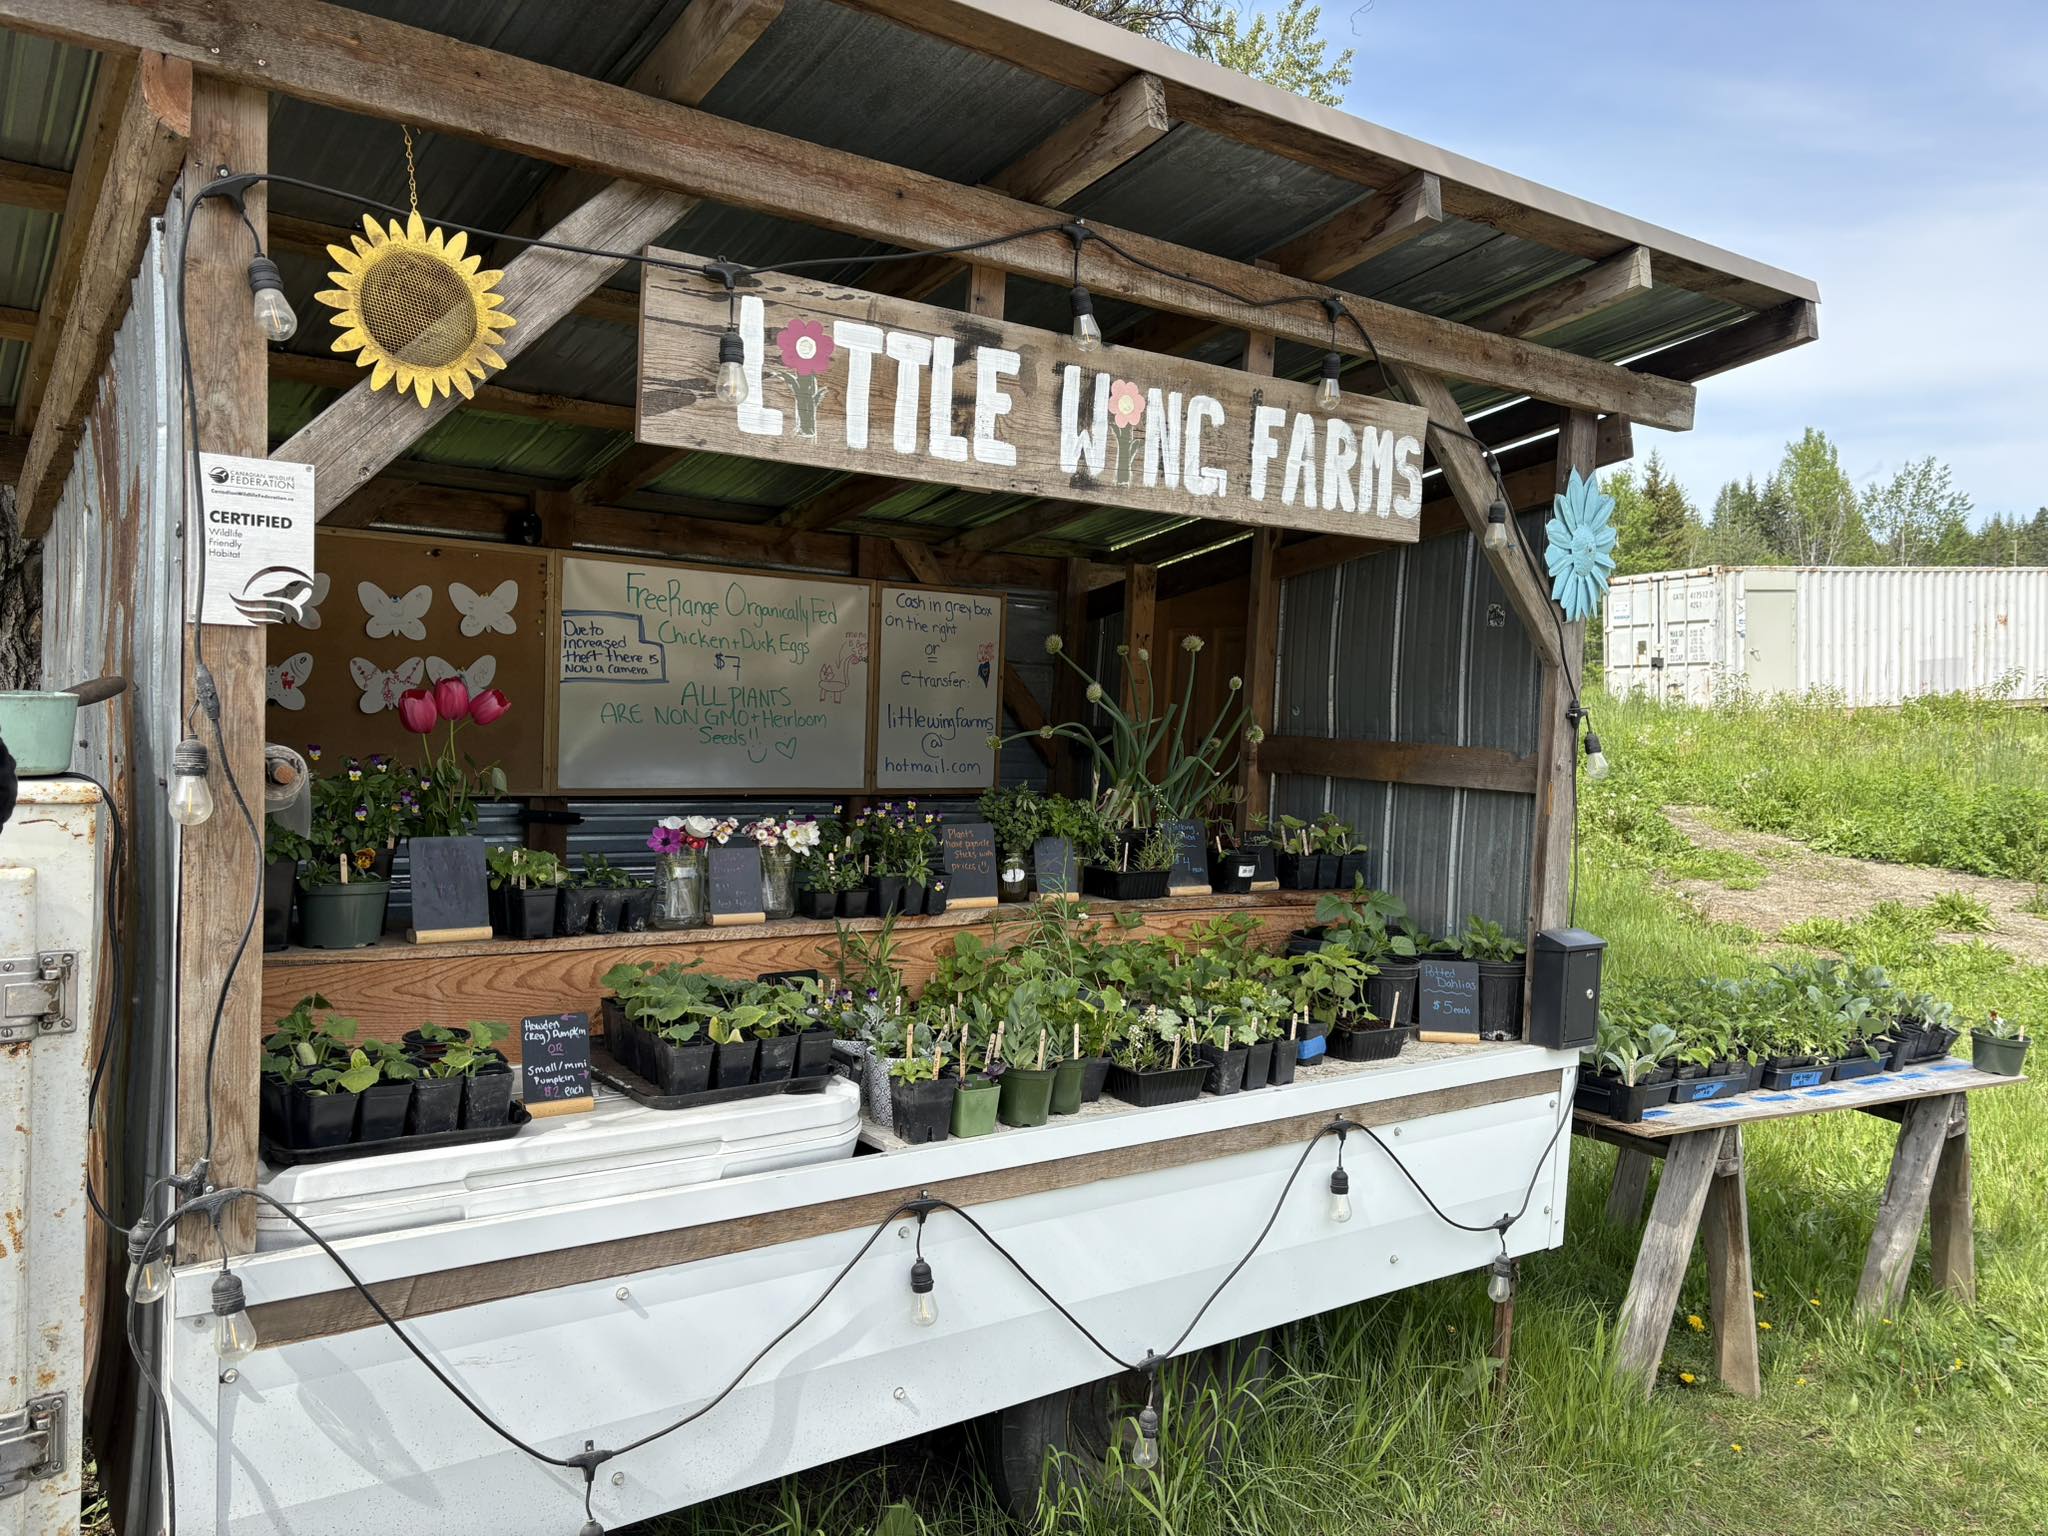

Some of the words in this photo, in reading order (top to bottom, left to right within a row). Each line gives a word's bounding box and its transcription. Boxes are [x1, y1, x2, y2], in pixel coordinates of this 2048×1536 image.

[1251, 405, 1423, 519] FARMS
[230, 470, 266, 478] CANADIAN
[268, 474, 295, 482] WILDLIFE
[230, 476, 295, 489] FEDERATION
[209, 510, 293, 529] CERTIFIED
[208, 528, 243, 538] Wildlife
[209, 538, 242, 548] Friendly
[209, 549, 241, 558] Habitat
[726, 582, 809, 638] Organically
[810, 597, 837, 625] Fed
[896, 593, 925, 610] Cash
[929, 599, 942, 613] in
[945, 600, 972, 622] grey
[974, 600, 993, 617] box
[563, 620, 588, 636] Due
[590, 621, 604, 636] to
[885, 612, 904, 626] on
[906, 614, 928, 633] the
[932, 622, 958, 643] right
[563, 636, 627, 650] increased
[658, 620, 730, 649] Chicken
[740, 628, 776, 655] Duck
[780, 633, 810, 664] Eggs
[562, 649, 602, 663] theft
[605, 649, 643, 663] there
[649, 654, 659, 664] is
[924, 643, 940, 656] or
[596, 666, 604, 674] a
[608, 665, 648, 675] camera
[714, 652, 741, 682] $7
[681, 681, 727, 706] ALL
[600, 702, 643, 724] ARE
[654, 705, 699, 726] NON
[705, 706, 749, 727] GMO
[763, 709, 828, 728] Heirloom
[887, 703, 994, 741] littlewingfarms
[921, 732, 944, 759] @
[885, 756, 981, 776] hotmail.com
[1424, 964, 1456, 977] Potted
[1437, 977, 1476, 990] Dahlias
[525, 1019, 560, 1031] Howden
[547, 1043, 564, 1053] OR
[533, 1073, 575, 1085] Pumpkin
[564, 1085, 584, 1097] each
